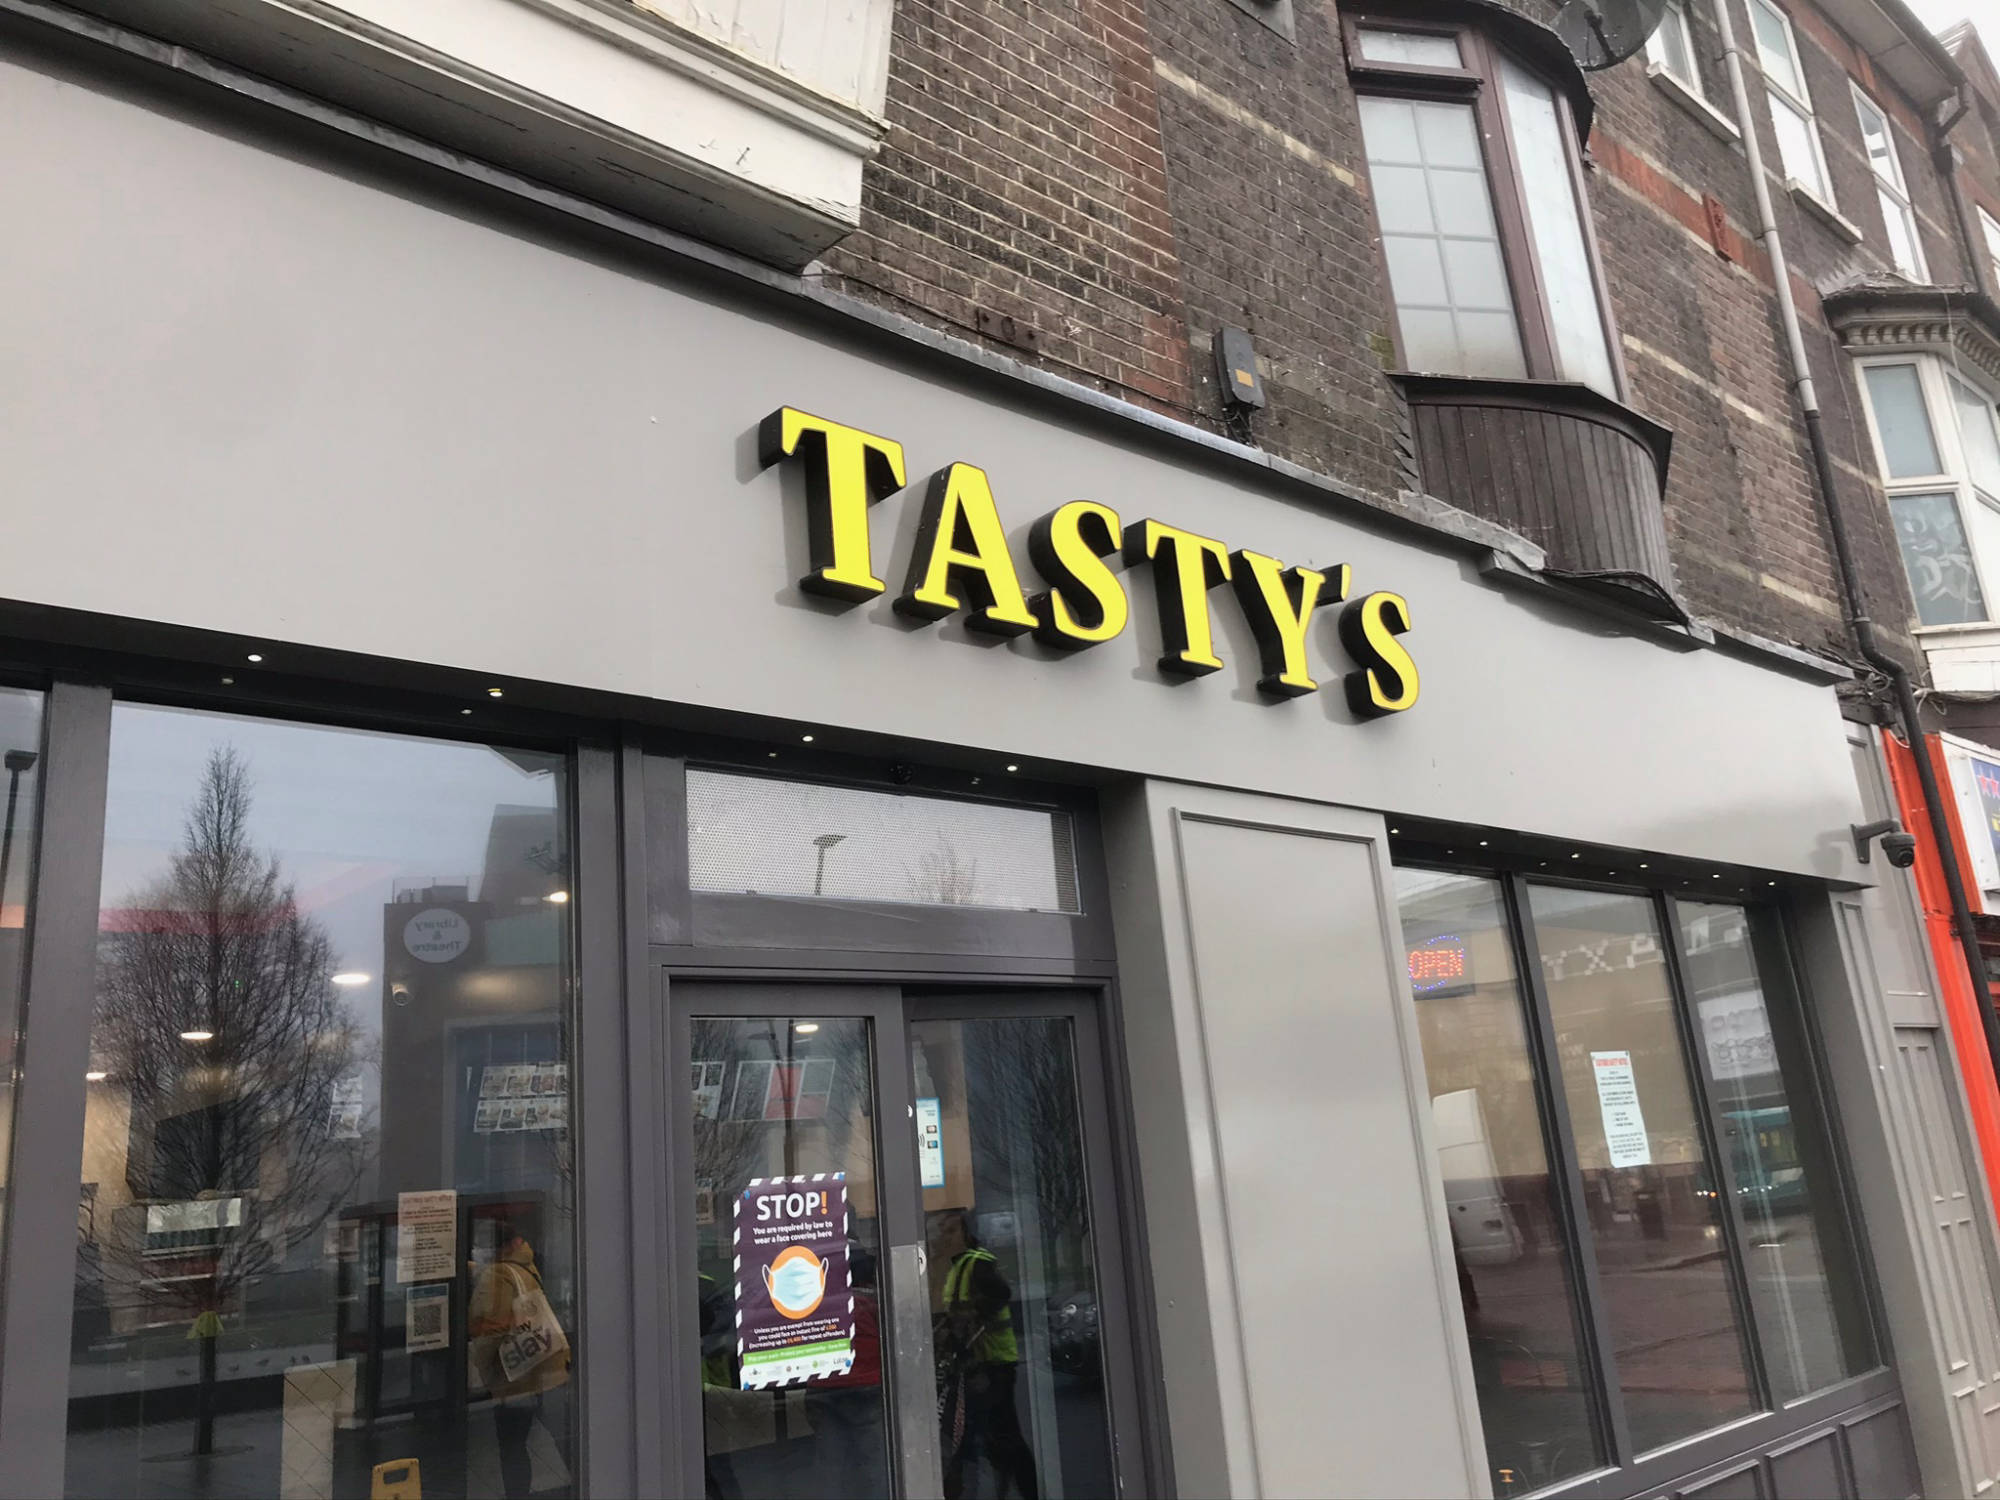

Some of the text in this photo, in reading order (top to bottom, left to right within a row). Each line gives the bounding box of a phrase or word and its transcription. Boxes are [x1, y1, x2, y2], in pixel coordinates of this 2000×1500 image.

[777, 405, 1420, 714] TASTY'S
[1408, 949, 1463, 979] OPEN
[756, 1190, 829, 1221] STOP!
[752, 1220, 833, 1235] You are required by law to
[754, 1236, 771, 1245] wear
[776, 1234, 790, 1242] face
[790, 1231, 817, 1241] covering
[817, 1230, 833, 1238] here
[504, 1328, 552, 1369] slay
